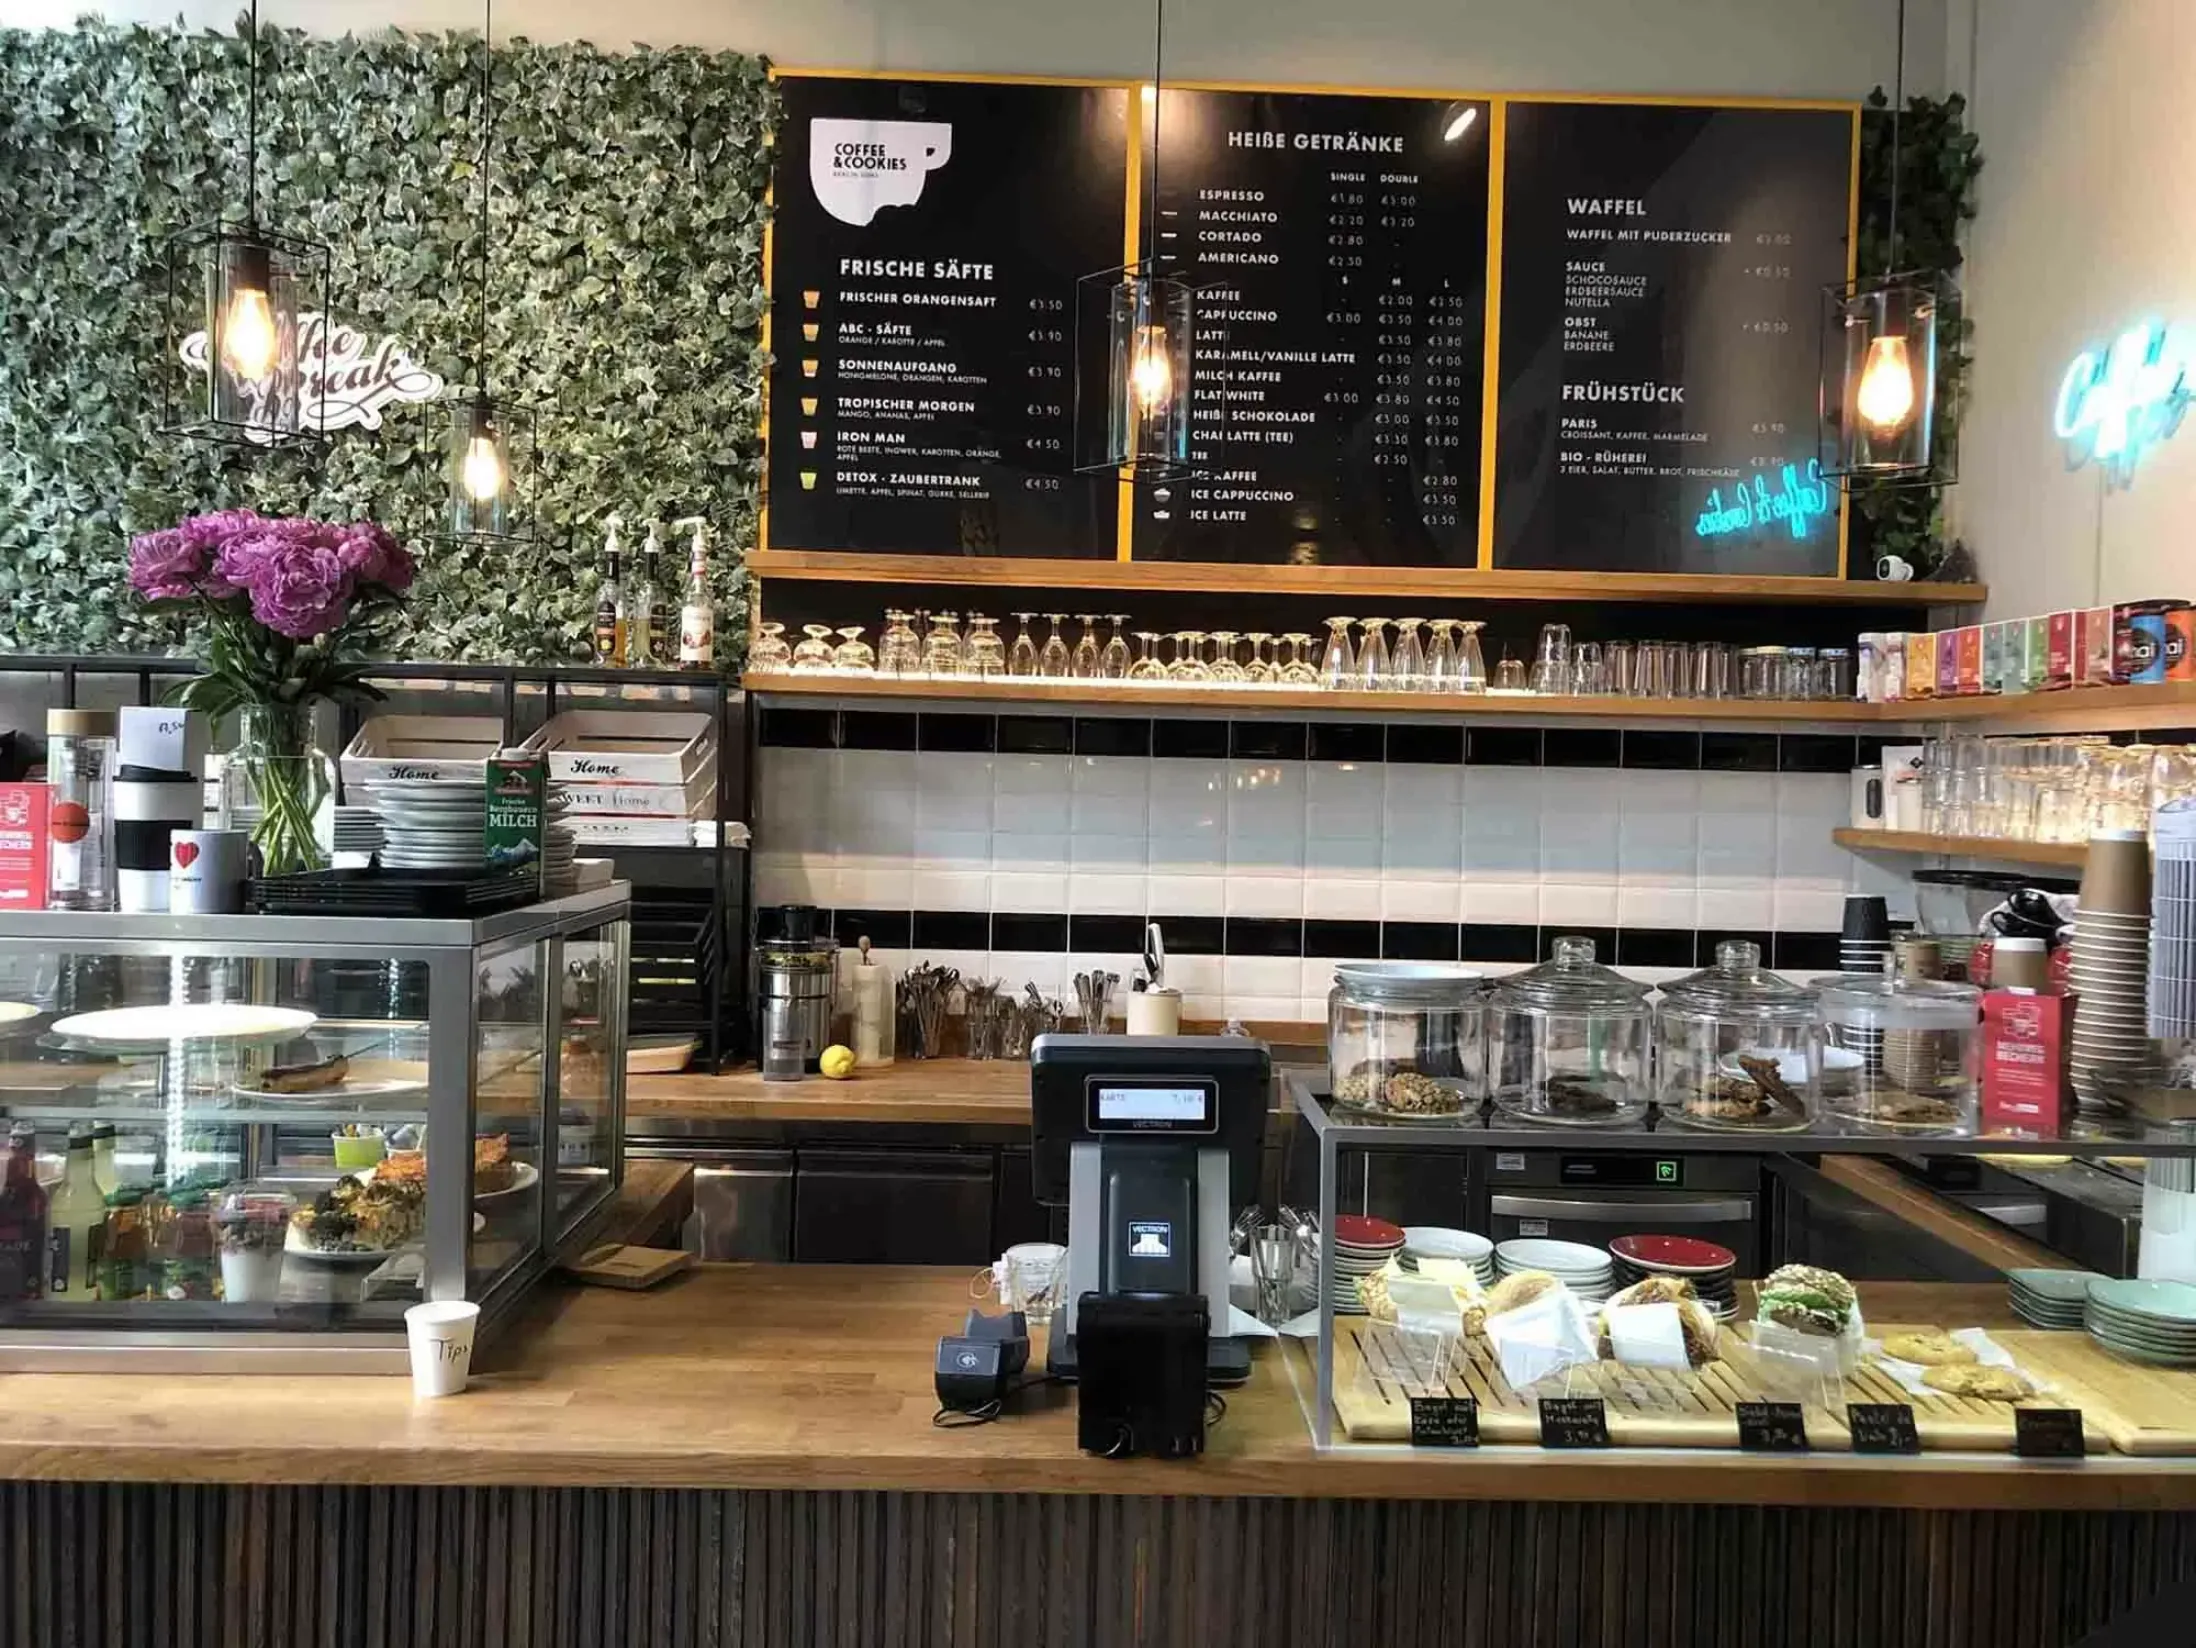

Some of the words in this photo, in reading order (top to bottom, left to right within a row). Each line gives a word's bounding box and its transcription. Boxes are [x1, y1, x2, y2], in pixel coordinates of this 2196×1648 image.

[1293, 132, 1404, 153] GETRÄNKE
[835, 143, 886, 156] COFFEE
[1330, 172, 1366, 182] SINGLE
[1380, 173, 1419, 184] DOUBLE
[1199, 189, 1265, 202] ESPRESSO
[1567, 198, 1647, 216] WAFFEL
[1199, 211, 1278, 224] MACCHIATO
[1198, 231, 1263, 244] CORTADO
[1566, 228, 1613, 242] WAFFEL
[1618, 229, 1639, 241] MIT
[1643, 230, 1732, 244] PUDERZUCKER
[1198, 251, 1280, 265] AMERICANO
[840, 258, 926, 278] FRISCHE
[933, 259, 994, 280] SÄFTE
[1565, 261, 1606, 274] SAUCE
[1565, 274, 1647, 286] SCHOCOSAUCE
[1197, 290, 1240, 301] KAFFEE
[1565, 286, 1644, 298] ERDBEERSAUCE
[839, 291, 899, 304] FRISCHER
[903, 293, 997, 307] ORANGENSAFT
[1565, 297, 1611, 309] NUTELLA
[838, 323, 864, 334] ABC
[876, 322, 913, 335] SÄFTE
[1564, 317, 1597, 328] OBST
[1564, 328, 1609, 340] BANANE
[1563, 340, 1615, 352] ERDBEERE
[1321, 352, 1356, 364] LATTE
[838, 359, 957, 373] SONNENAUFGANG
[1195, 370, 1234, 381] MILCH
[1238, 371, 1282, 382] KAFFEE
[1194, 389, 1222, 400] FLAT
[1226, 390, 1265, 401] WHITE
[1562, 380, 1685, 403] FRÜHSTÜCK
[837, 397, 915, 410] TROPISCHER
[918, 399, 975, 412] MORGEN
[1193, 409, 1226, 421] HEIß
[1231, 410, 1316, 423] SCHOKOLADE
[1561, 418, 1598, 430] PARIS
[836, 430, 870, 442] IRON
[874, 432, 906, 444] MAN
[1192, 430, 1223, 441] CHAI
[1227, 431, 1261, 442] LATTE
[1265, 431, 1294, 444] (TEE)
[1560, 451, 1583, 462] BIO
[1594, 450, 1647, 463] RÜHEREI
[836, 471, 877, 483] DETOX
[889, 473, 981, 486] ZAUBERTRANK
[1191, 489, 1209, 500] ICE
[1213, 490, 1294, 502] CAPPUCCINO
[1190, 510, 1208, 520] ICE
[1213, 510, 1247, 522] LATTE
[388, 764, 440, 780] Home
[570, 759, 621, 775] Home
[489, 813, 537, 828] MILCH
